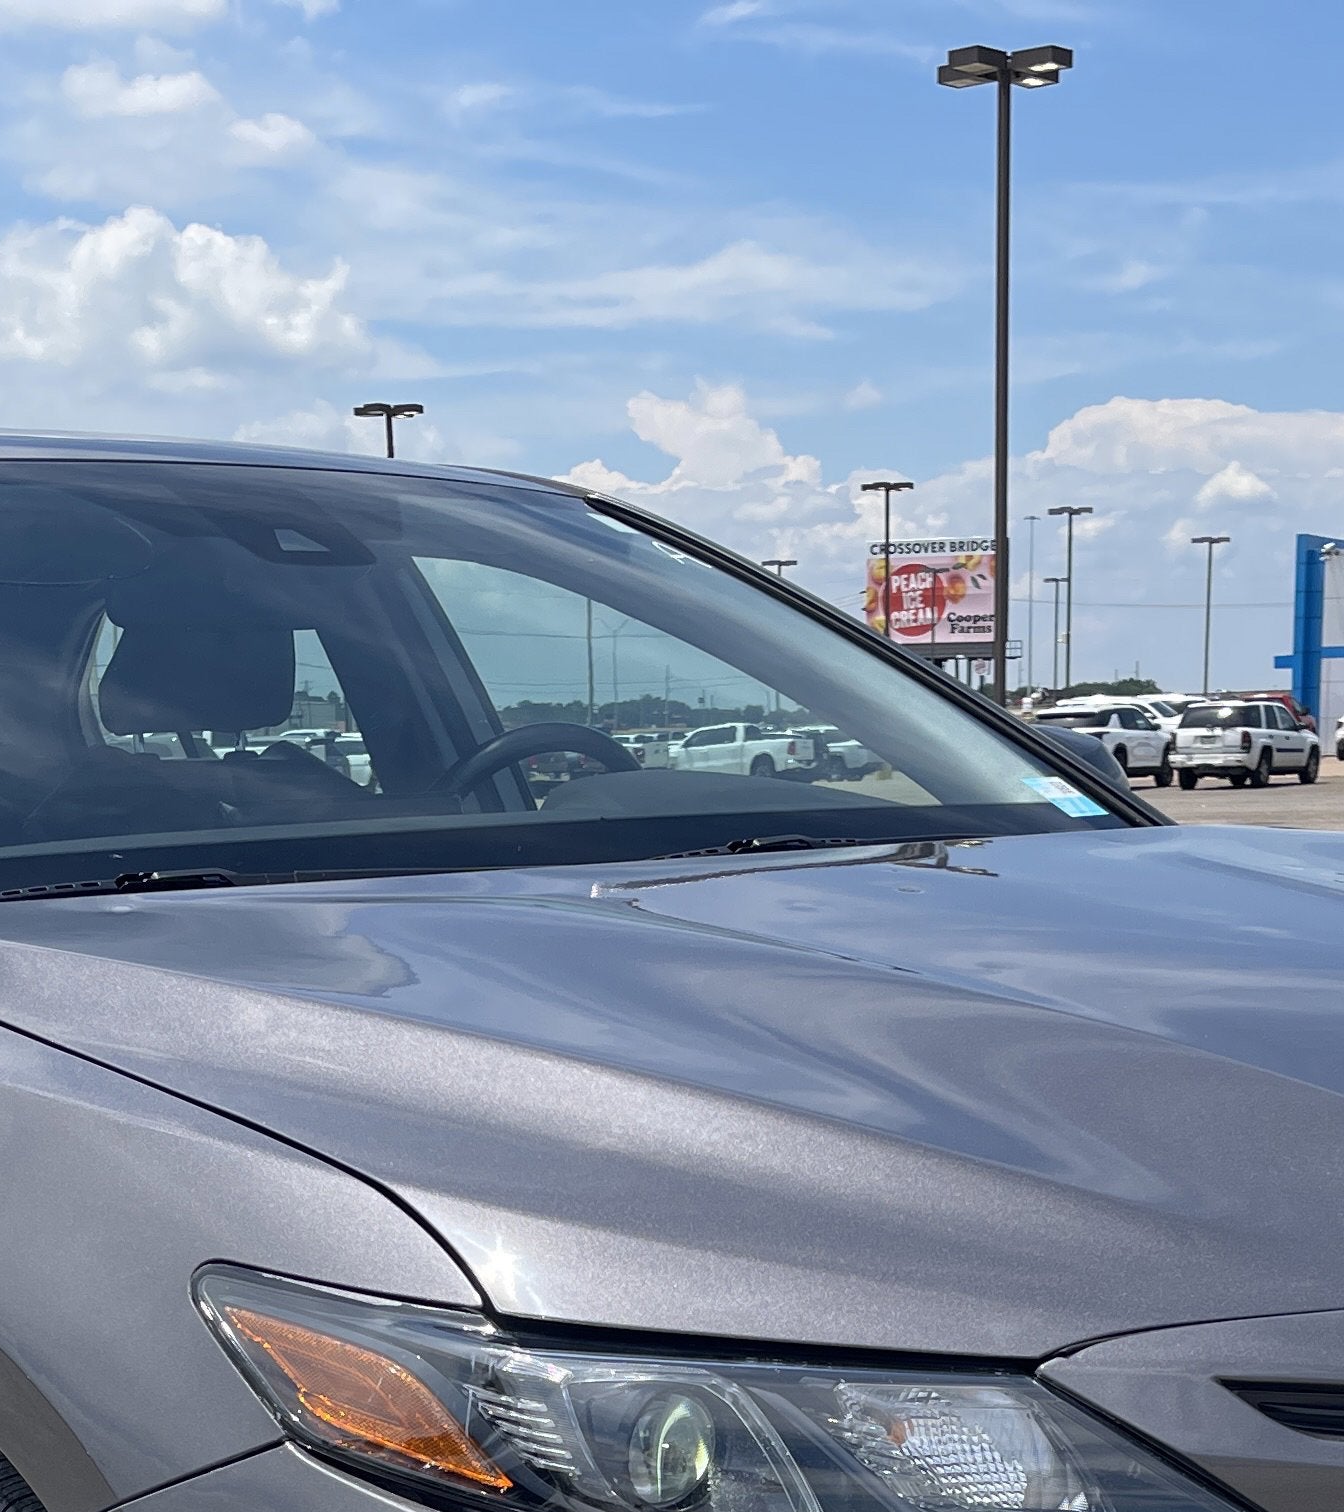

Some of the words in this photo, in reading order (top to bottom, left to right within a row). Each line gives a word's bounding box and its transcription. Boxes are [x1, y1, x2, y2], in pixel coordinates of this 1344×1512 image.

[870, 541, 946, 556] CROSSOVER
[949, 539, 997, 553] BRIDGE
[891, 571, 934, 593] PEACH
[902, 591, 925, 610] ICE
[890, 606, 938, 629] CREAM
[946, 611, 994, 625] Cooper
[949, 624, 992, 634] Farms
